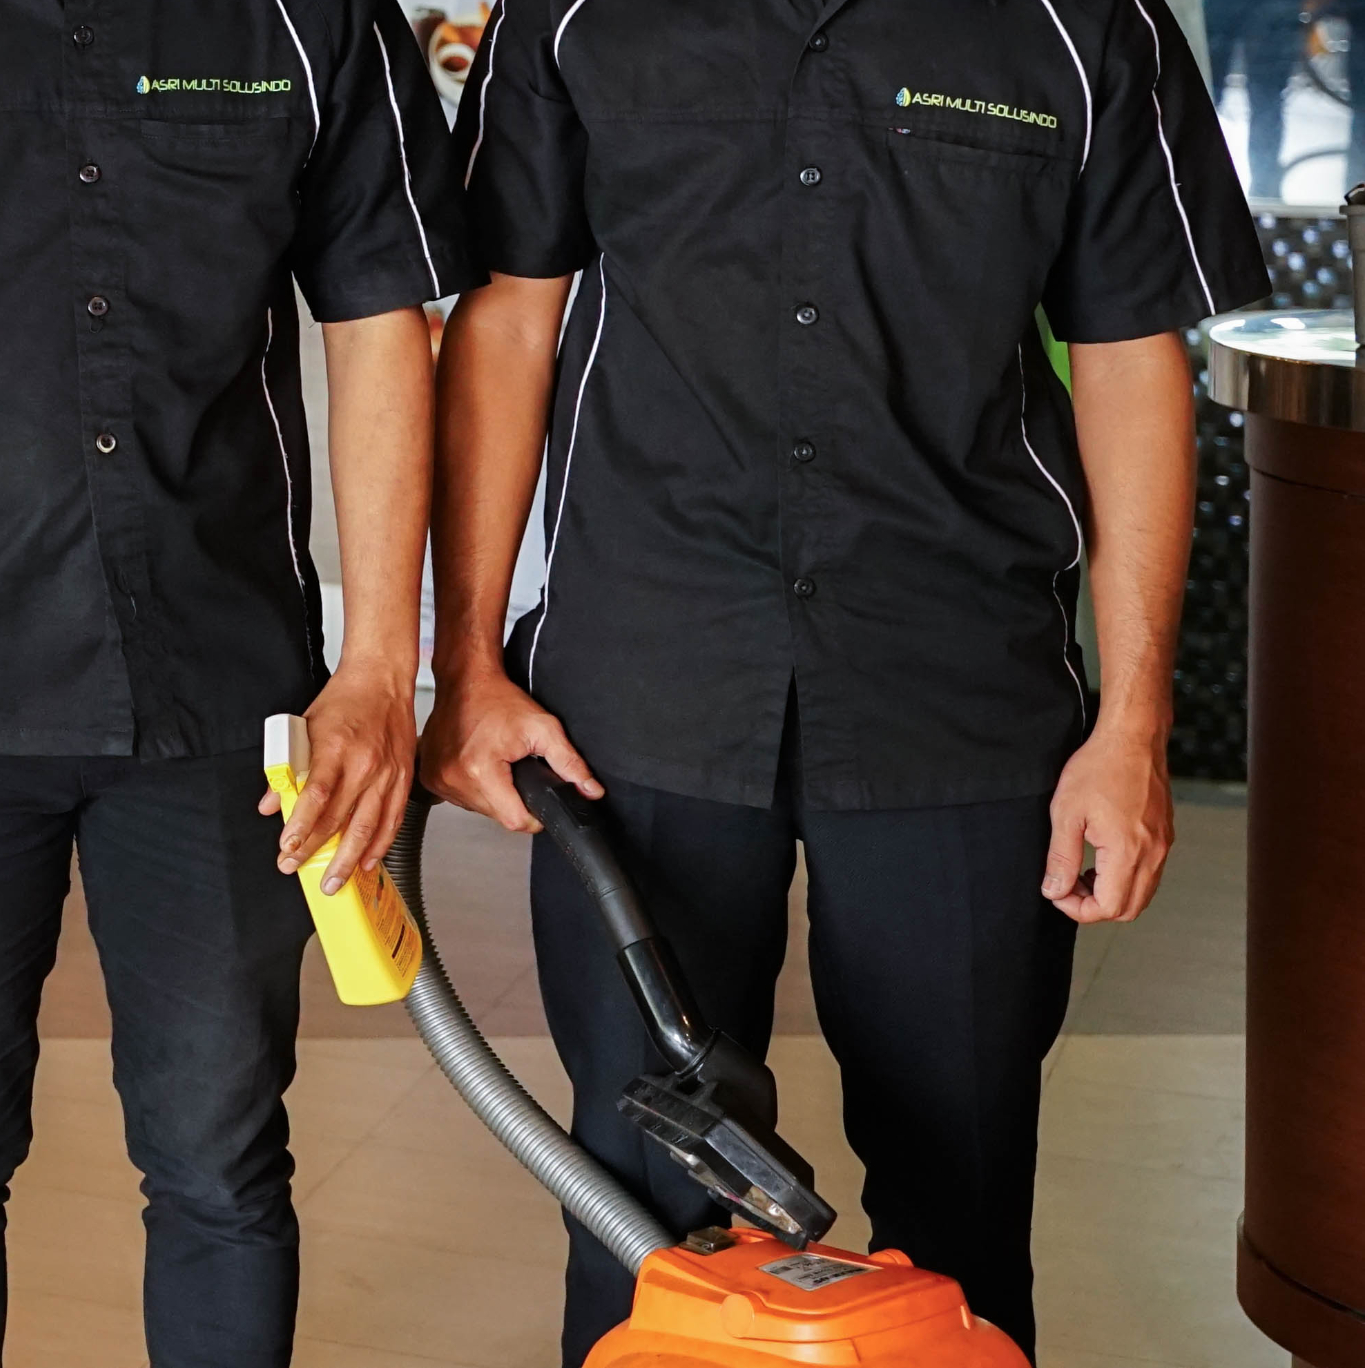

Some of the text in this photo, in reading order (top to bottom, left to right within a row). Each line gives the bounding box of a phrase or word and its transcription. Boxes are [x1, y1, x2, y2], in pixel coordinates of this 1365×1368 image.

[151, 78, 291, 94] ASRI MULTI SOLUSINDO
[912, 92, 1057, 128] ASRI MULTI SOLUSINDO
